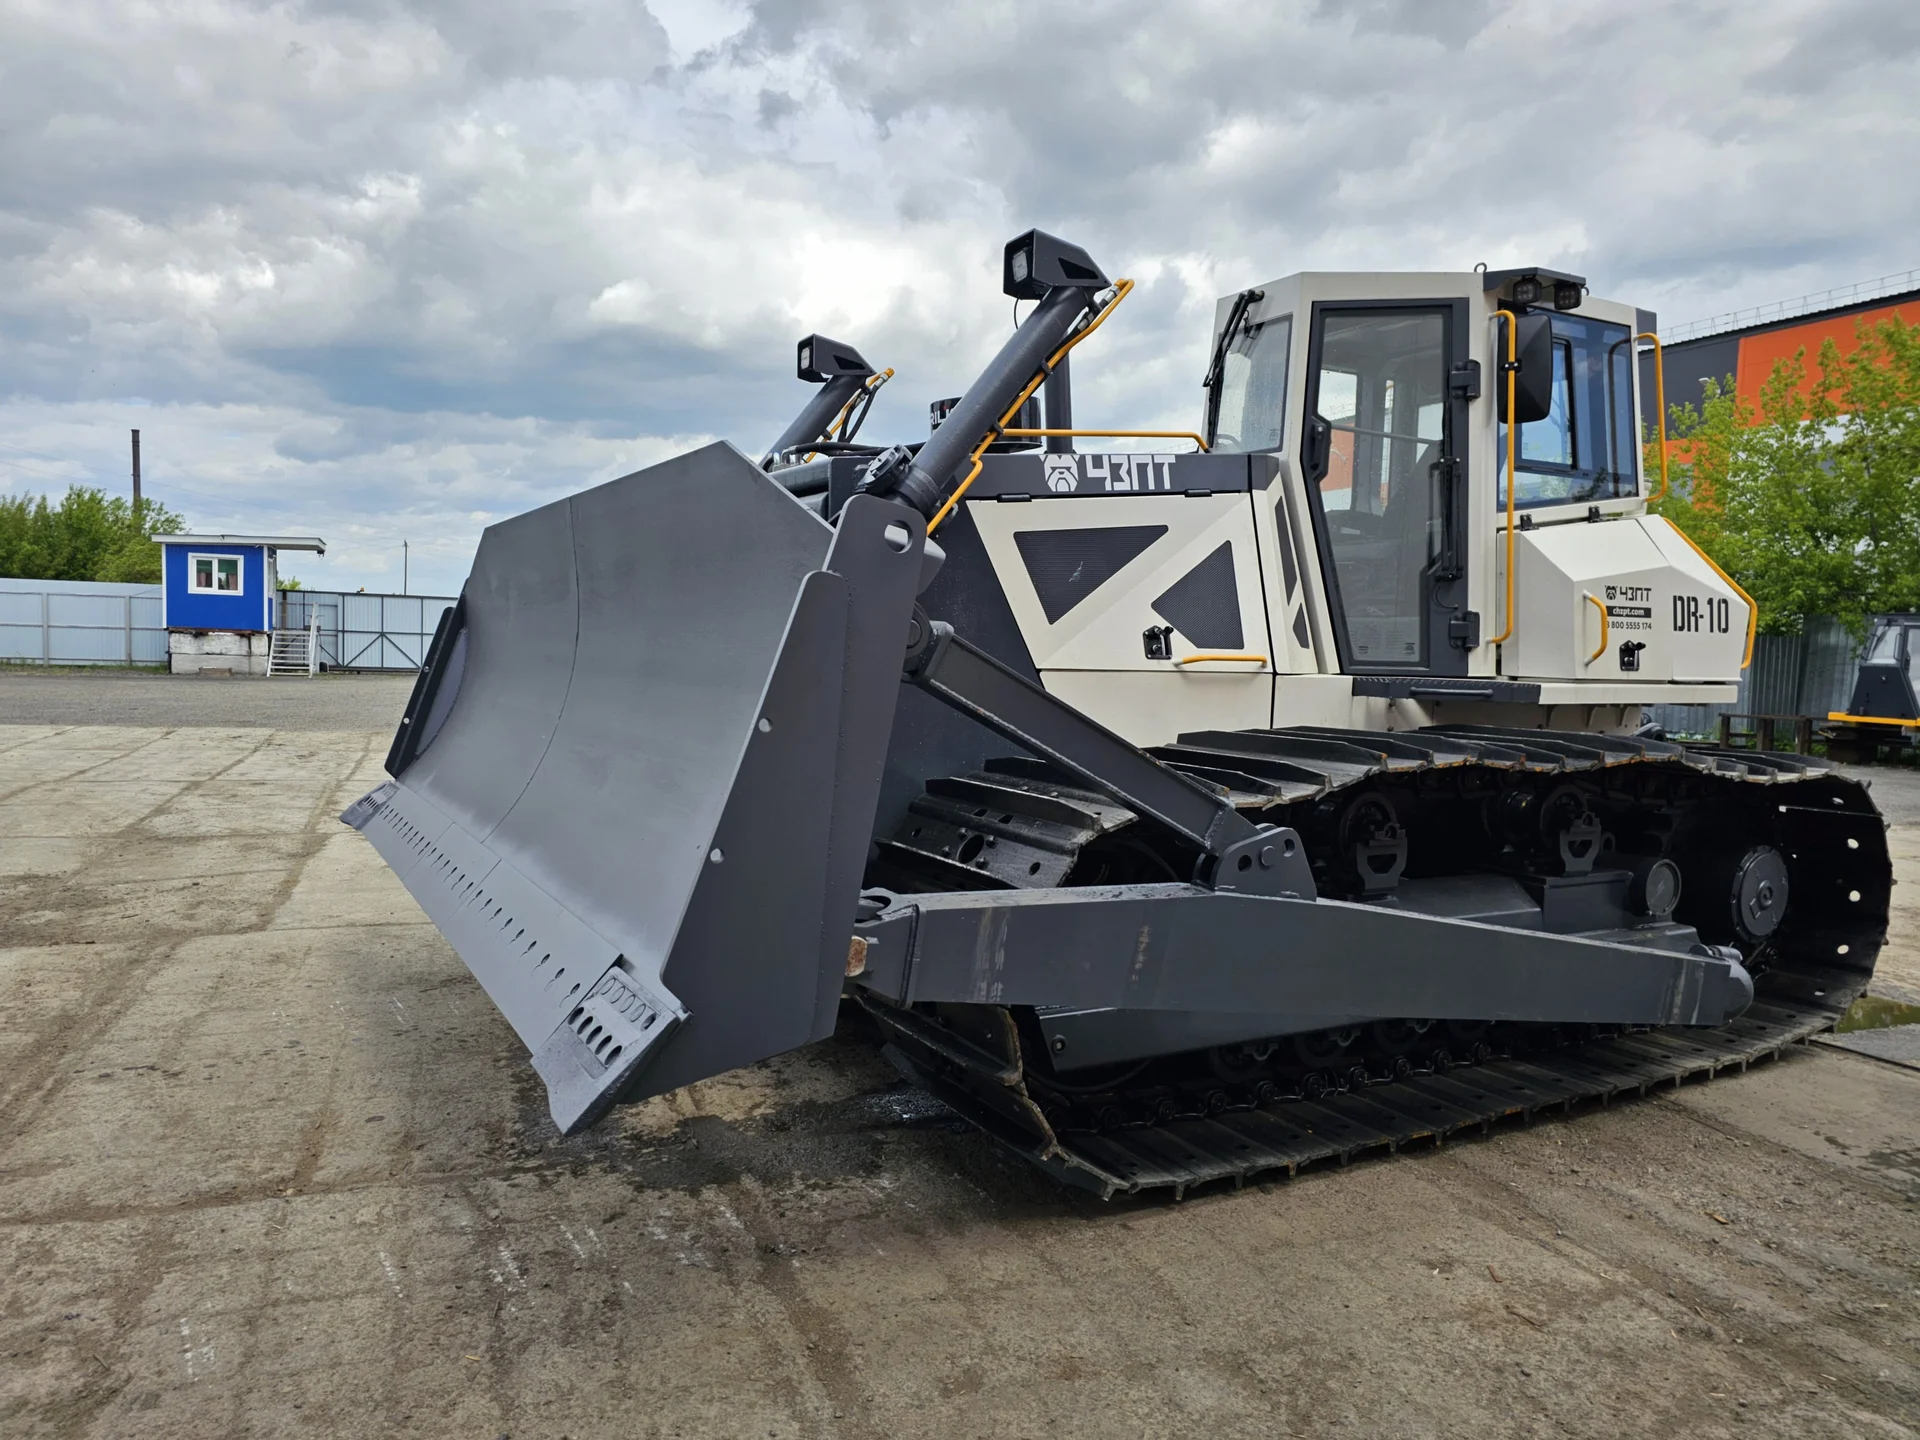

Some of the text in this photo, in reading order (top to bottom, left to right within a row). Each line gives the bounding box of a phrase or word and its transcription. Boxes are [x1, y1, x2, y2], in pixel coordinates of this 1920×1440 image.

[1085, 454, 1176, 491] ЧЗПТ
[1619, 586, 1652, 602] ЧЗПТ
[1612, 606, 1645, 617] chzpt.com
[1672, 595, 1729, 634] DR-10
[1611, 621, 1625, 629] 800
[1625, 621, 1641, 630] 5555
[1641, 622, 1652, 630] 174
